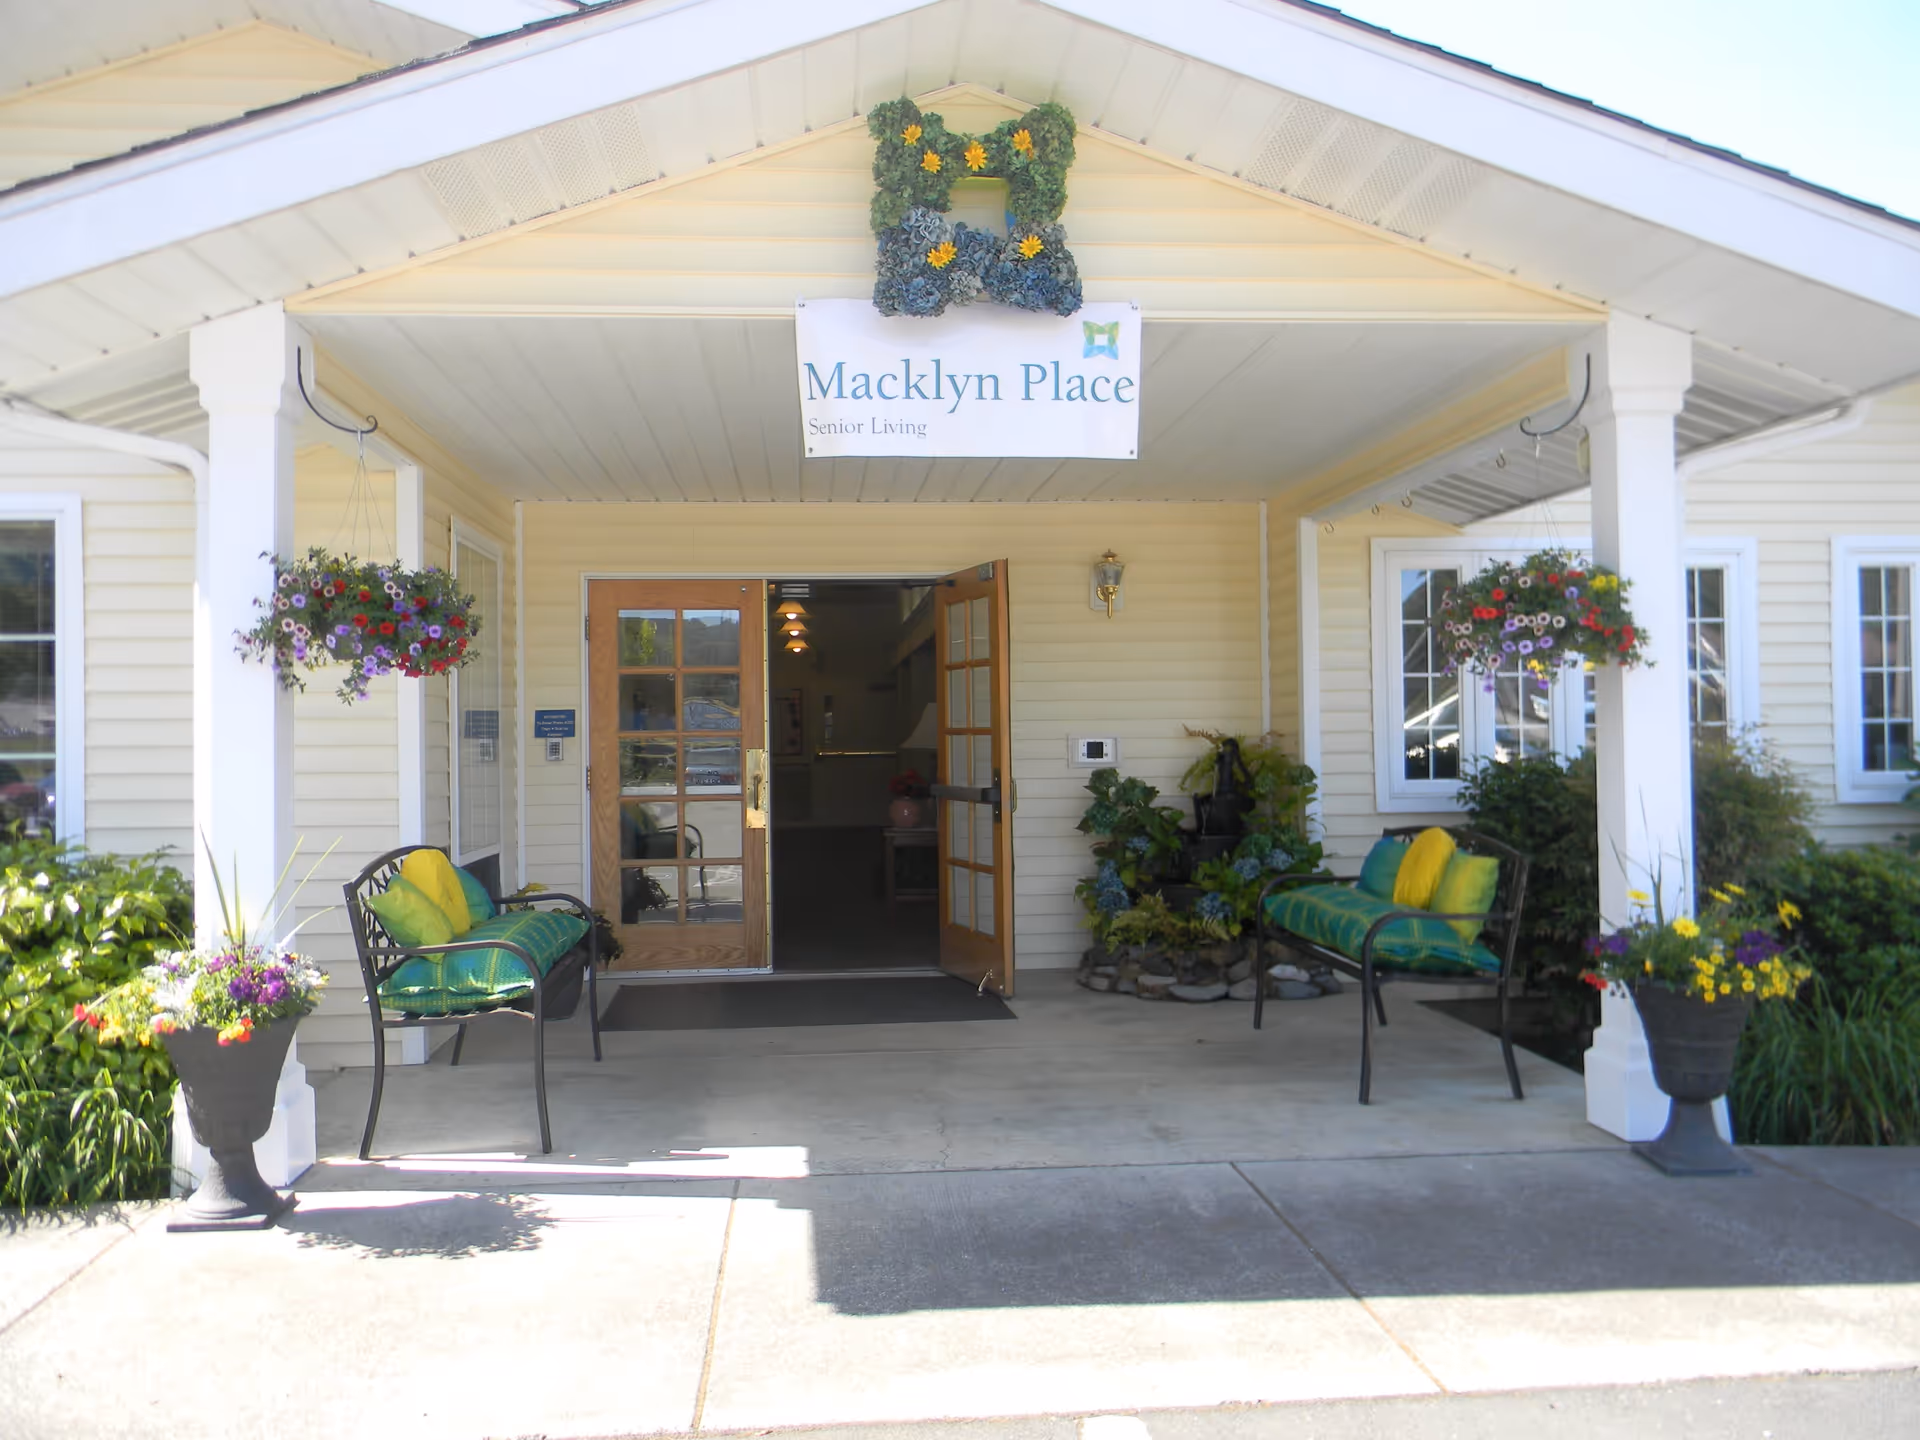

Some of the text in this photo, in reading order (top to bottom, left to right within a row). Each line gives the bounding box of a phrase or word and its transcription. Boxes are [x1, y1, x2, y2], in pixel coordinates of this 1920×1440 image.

[803, 358, 1135, 414] Macklyn Place
[808, 417, 927, 439] Senior Living
